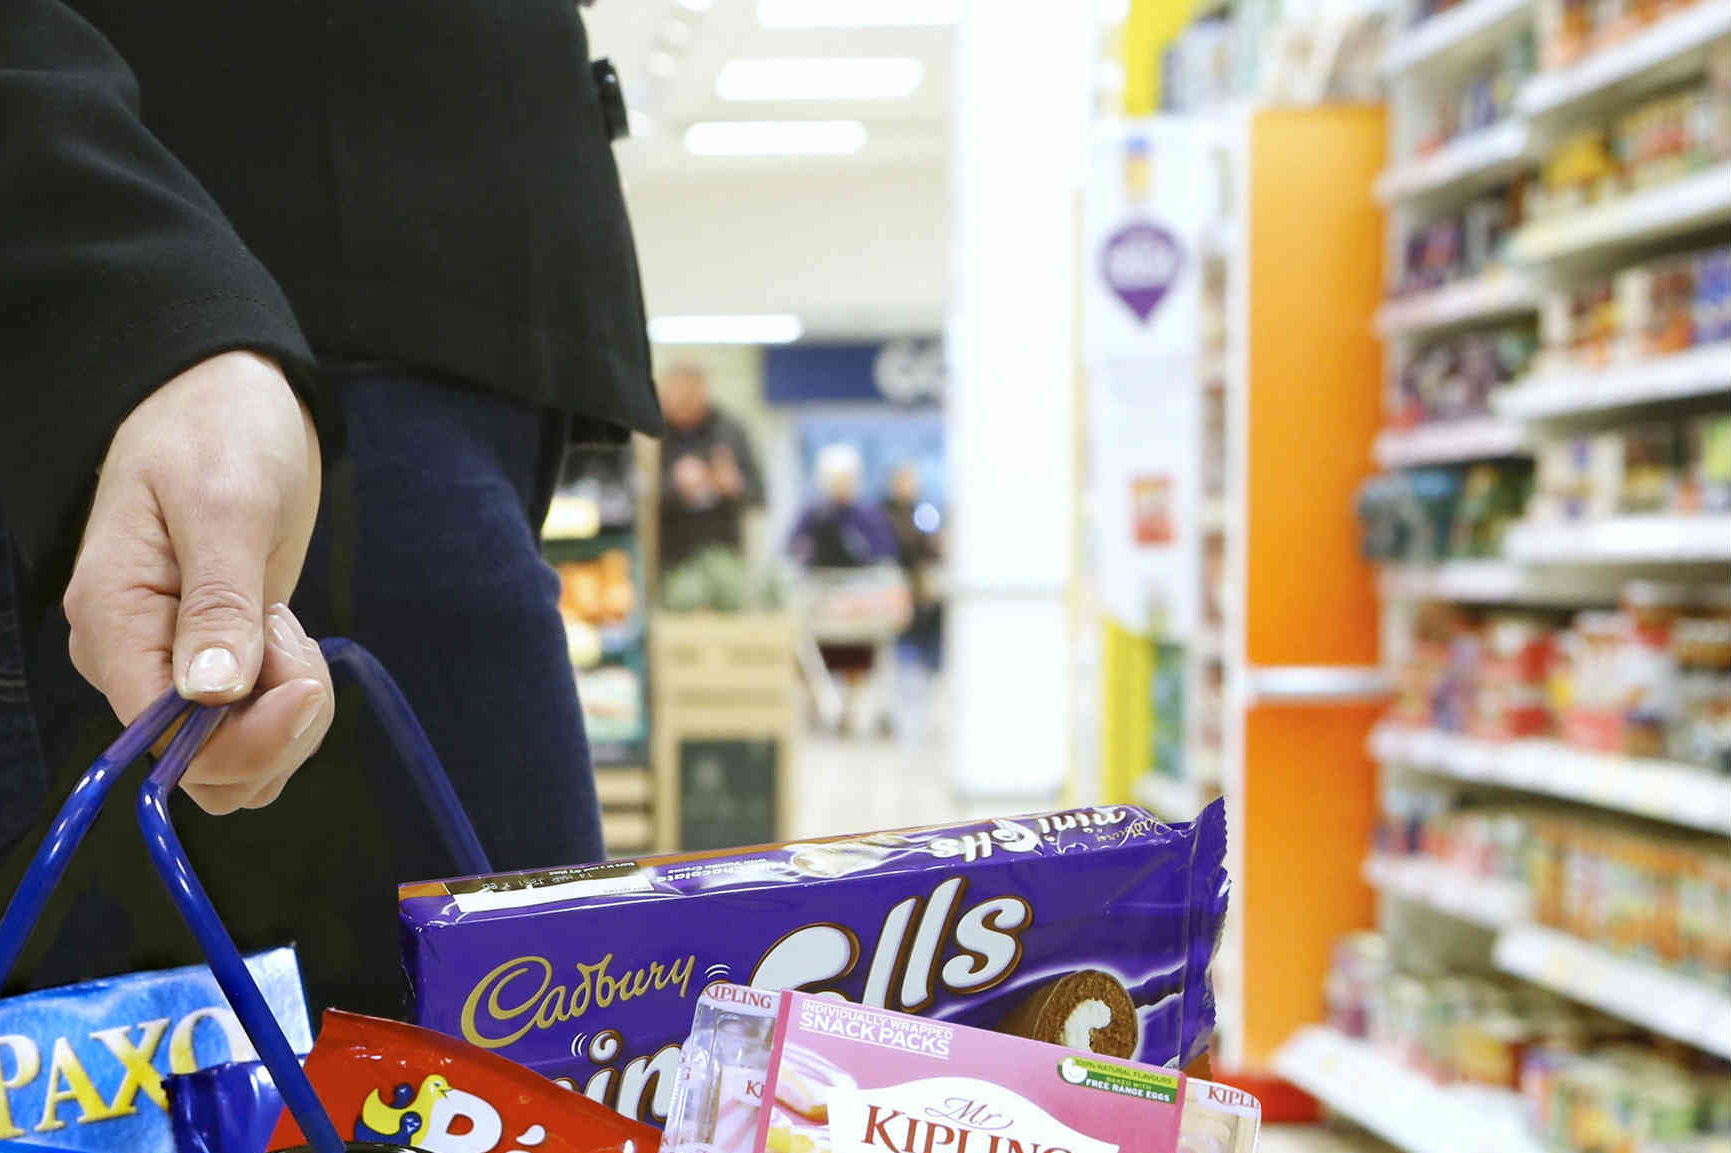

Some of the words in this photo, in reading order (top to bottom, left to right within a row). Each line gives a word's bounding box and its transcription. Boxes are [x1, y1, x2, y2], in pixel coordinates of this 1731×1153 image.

[461, 951, 696, 1050] Cadbury
[702, 986, 772, 1010] KIPLING
[799, 1013, 877, 1043] SNACK
[878, 1030, 951, 1056] PACKS
[801, 999, 888, 1027] INDIVIDUALLY
[889, 1016, 954, 1042] WRAPPED
[1085, 1077, 1110, 1091] FREE
[1112, 1084, 1145, 1098] RANGE
[1145, 1090, 1171, 1103] EGGS
